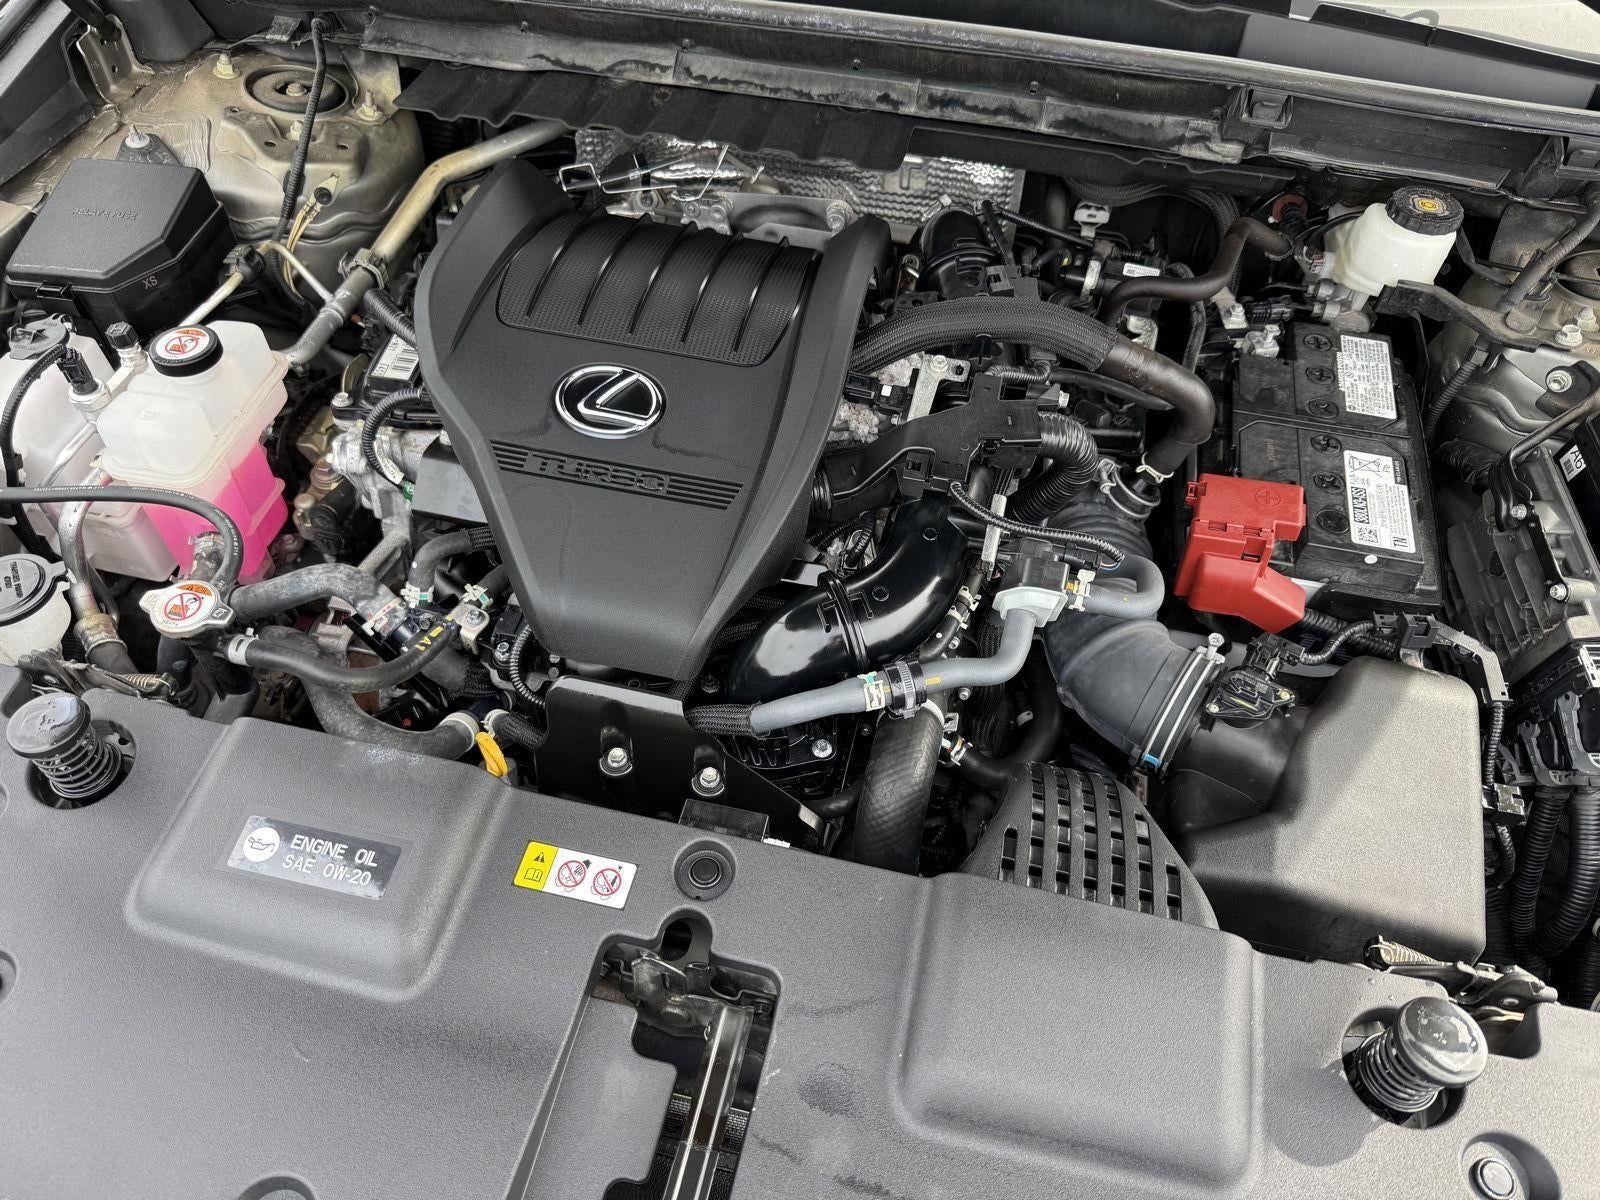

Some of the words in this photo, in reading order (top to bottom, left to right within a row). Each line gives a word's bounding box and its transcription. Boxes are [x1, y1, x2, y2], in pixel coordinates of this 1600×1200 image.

[72, 207, 103, 217] RELAY
[111, 210, 138, 220] FUSE
[142, 275, 158, 290] XS
[529, 452, 669, 493] TURBO
[290, 834, 348, 860] ENGINE
[354, 848, 378, 867] OIL
[282, 854, 317, 874] SAE
[323, 863, 372, 886] 0W-20
